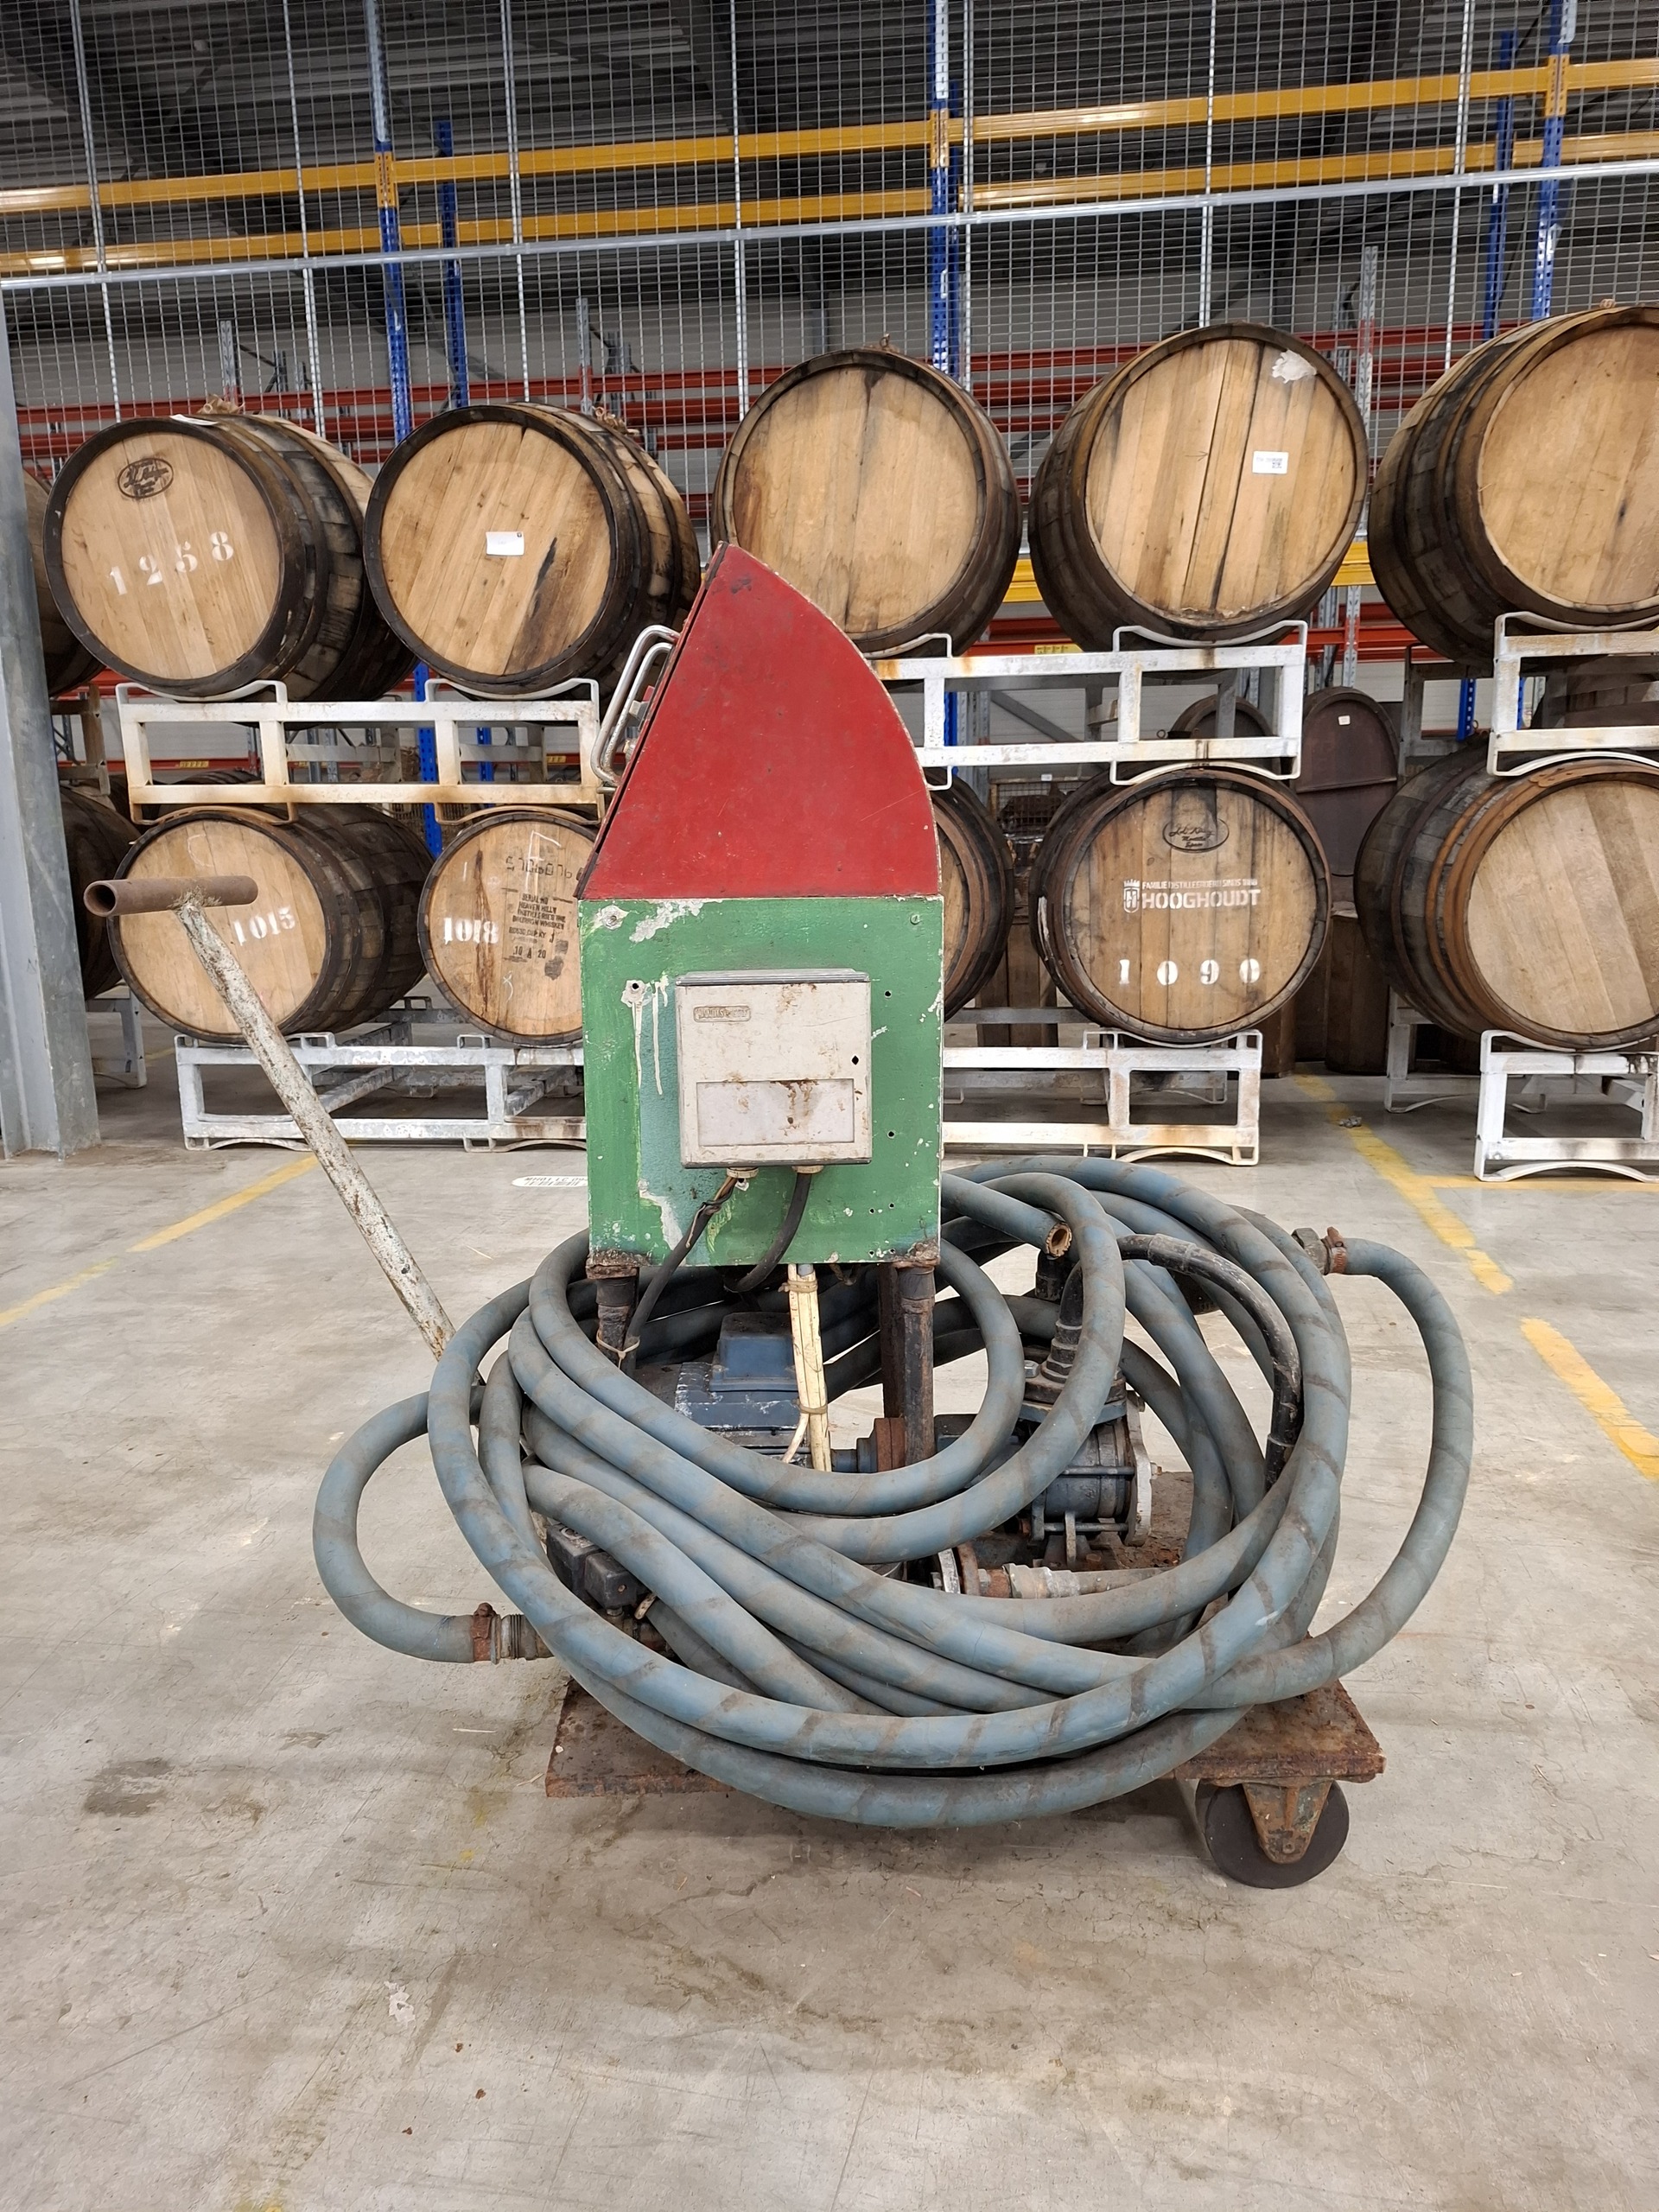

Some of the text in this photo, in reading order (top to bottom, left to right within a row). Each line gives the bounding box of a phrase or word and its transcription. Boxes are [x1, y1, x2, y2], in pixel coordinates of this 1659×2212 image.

[518, 900, 540, 912] HEAVEN
[1141, 889, 1261, 909] HOOGHOUDT
[233, 905, 296, 947] 1015
[443, 917, 499, 945] 1018
[1119, 958, 1261, 986] 1090
